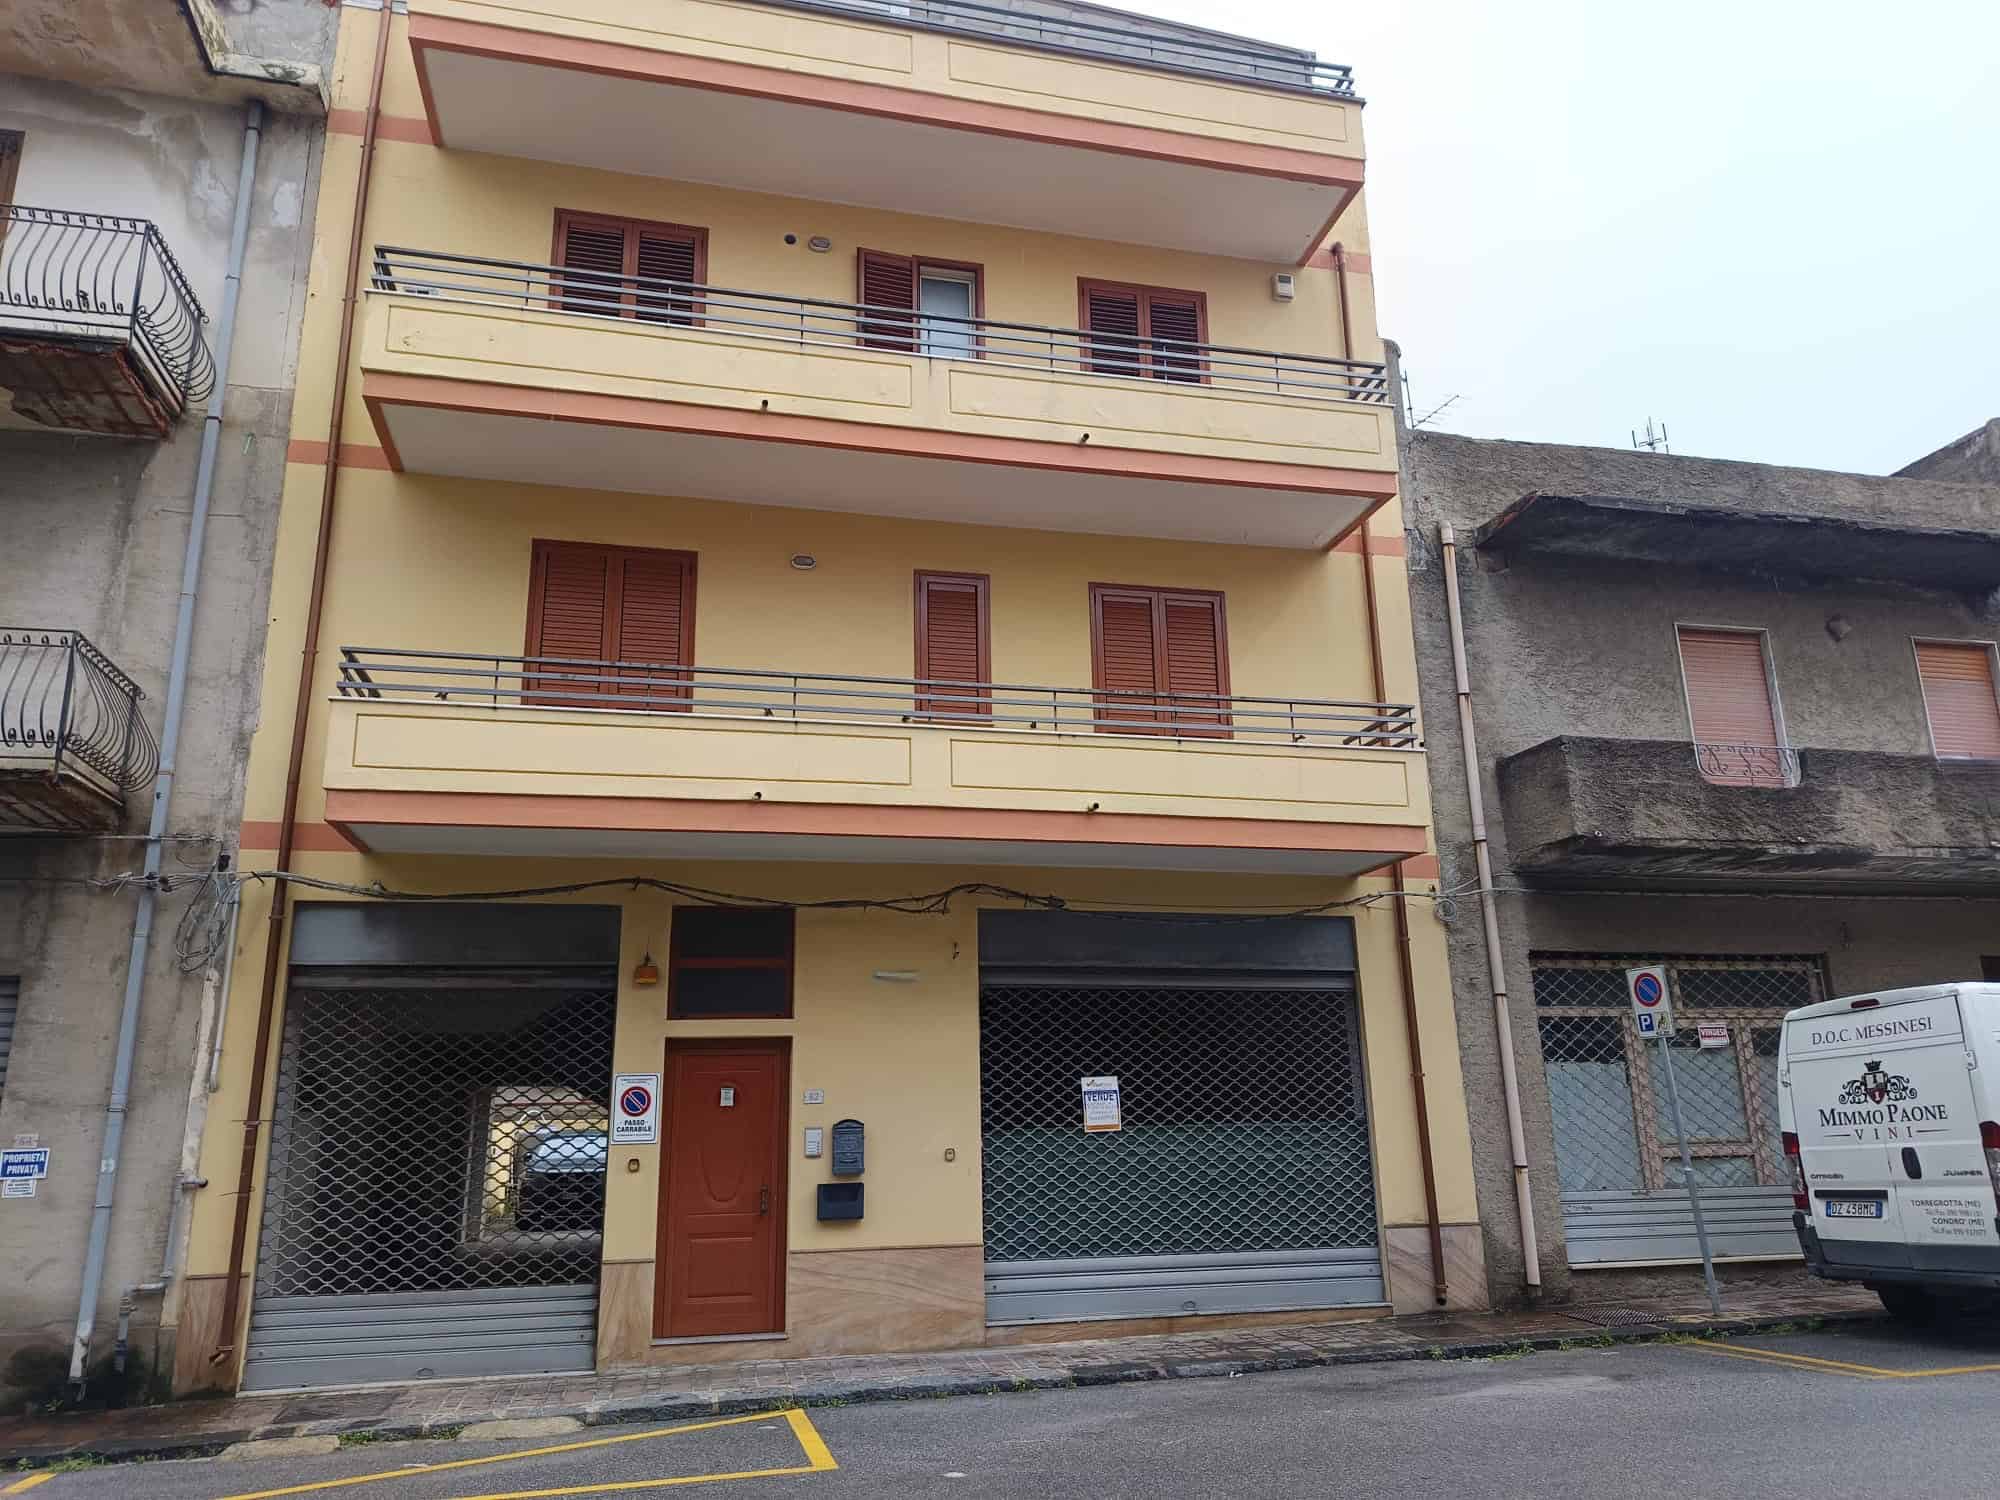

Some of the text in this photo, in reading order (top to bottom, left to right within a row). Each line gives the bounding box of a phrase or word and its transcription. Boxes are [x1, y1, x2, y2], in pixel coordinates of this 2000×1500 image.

[1641, 1016, 1650, 1030] P
[1812, 1016, 1932, 1045] D.O.C. MESSINESI
[1855, 1126, 1913, 1140] VINI
[7, 1165, 38, 1176] PRIVATA
[1943, 1169, 1983, 1177] JUMPER
